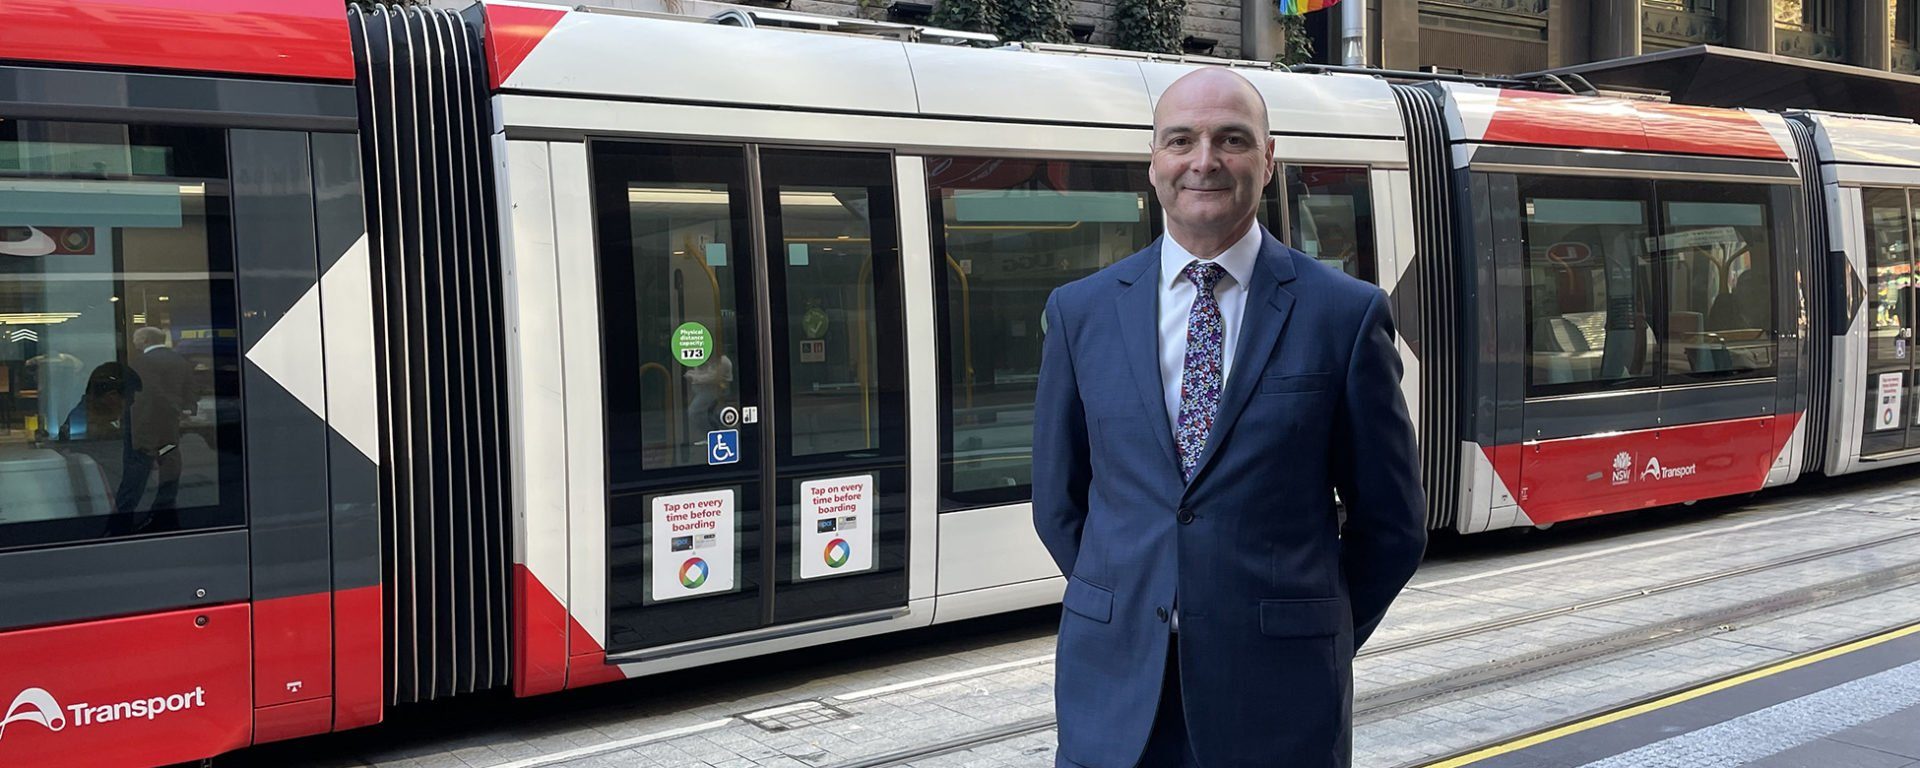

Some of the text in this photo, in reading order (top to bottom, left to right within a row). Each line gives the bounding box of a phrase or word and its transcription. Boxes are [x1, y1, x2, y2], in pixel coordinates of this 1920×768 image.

[680, 328, 703, 336] Physical
[683, 349, 703, 358] 173
[1612, 469, 1631, 482] NSW
[1661, 463, 1696, 479] Transport
[811, 487, 825, 496] Tap
[840, 483, 863, 492] every
[663, 503, 680, 512] Tap
[698, 499, 723, 508] every
[813, 493, 861, 505] time before
[818, 503, 856, 514] boarding
[666, 509, 721, 522] time before
[672, 519, 715, 532] boarding
[67, 686, 206, 726] Transport
